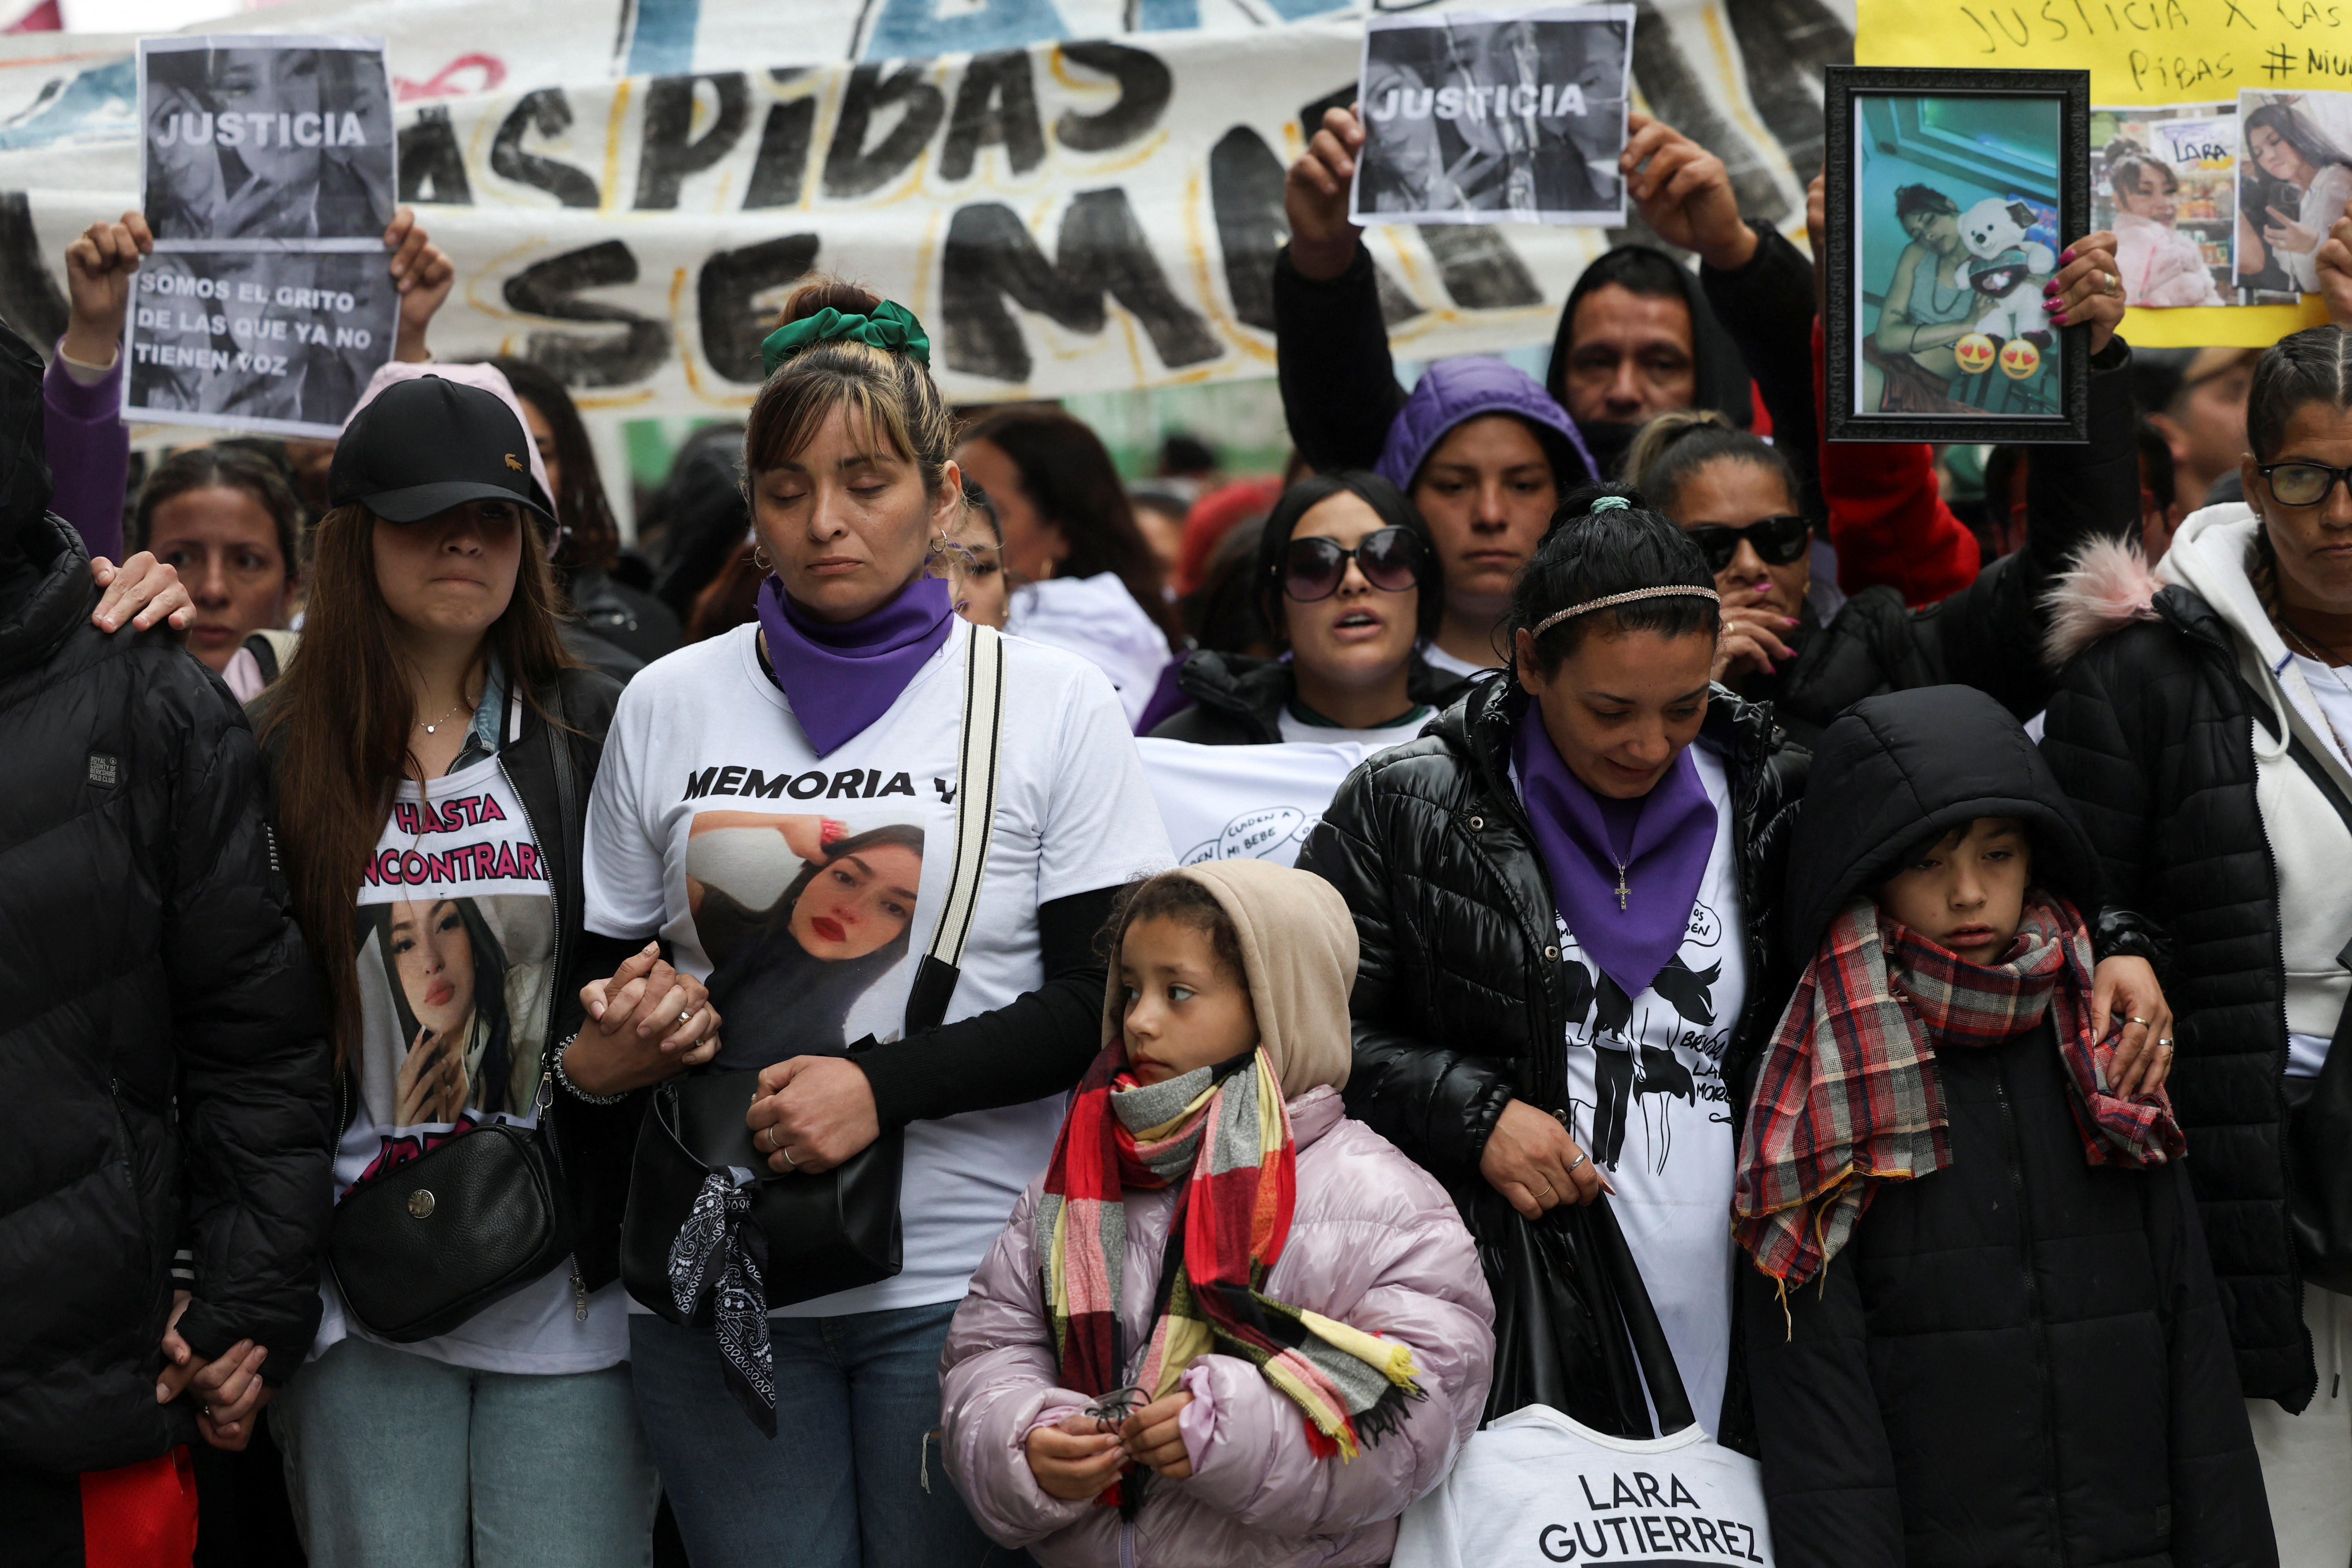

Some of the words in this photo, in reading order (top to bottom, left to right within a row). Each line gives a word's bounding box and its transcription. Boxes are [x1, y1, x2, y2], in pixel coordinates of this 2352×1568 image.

[1372, 83, 1588, 122] JUSTICIA
[157, 111, 367, 148] JUSTICIA
[397, 85, 601, 209] AS
[2173, 141, 2227, 163] LARA
[140, 273, 230, 300] SOMOS
[238, 282, 270, 304] EL
[276, 285, 355, 314] GRITO
[137, 308, 171, 330] DE
[179, 311, 227, 336] LAS
[235, 318, 288, 341] QUE
[295, 323, 329, 346] YA
[336, 327, 372, 350] NO
[134, 343, 229, 372] TIENEN
[237, 351, 288, 377] VOZ
[89, 773, 102, 781] POLO
[90, 762, 110, 771] COUNTY
[90, 768, 116, 778] BERKSHIRE
[91, 756, 106, 765] ROYAL
[681, 765, 916, 802] MEMORIA
[395, 793, 507, 835] HASTA
[1578, 1472, 1701, 1511] LARA
[1539, 1516, 1764, 1565] GUTIERREZ
